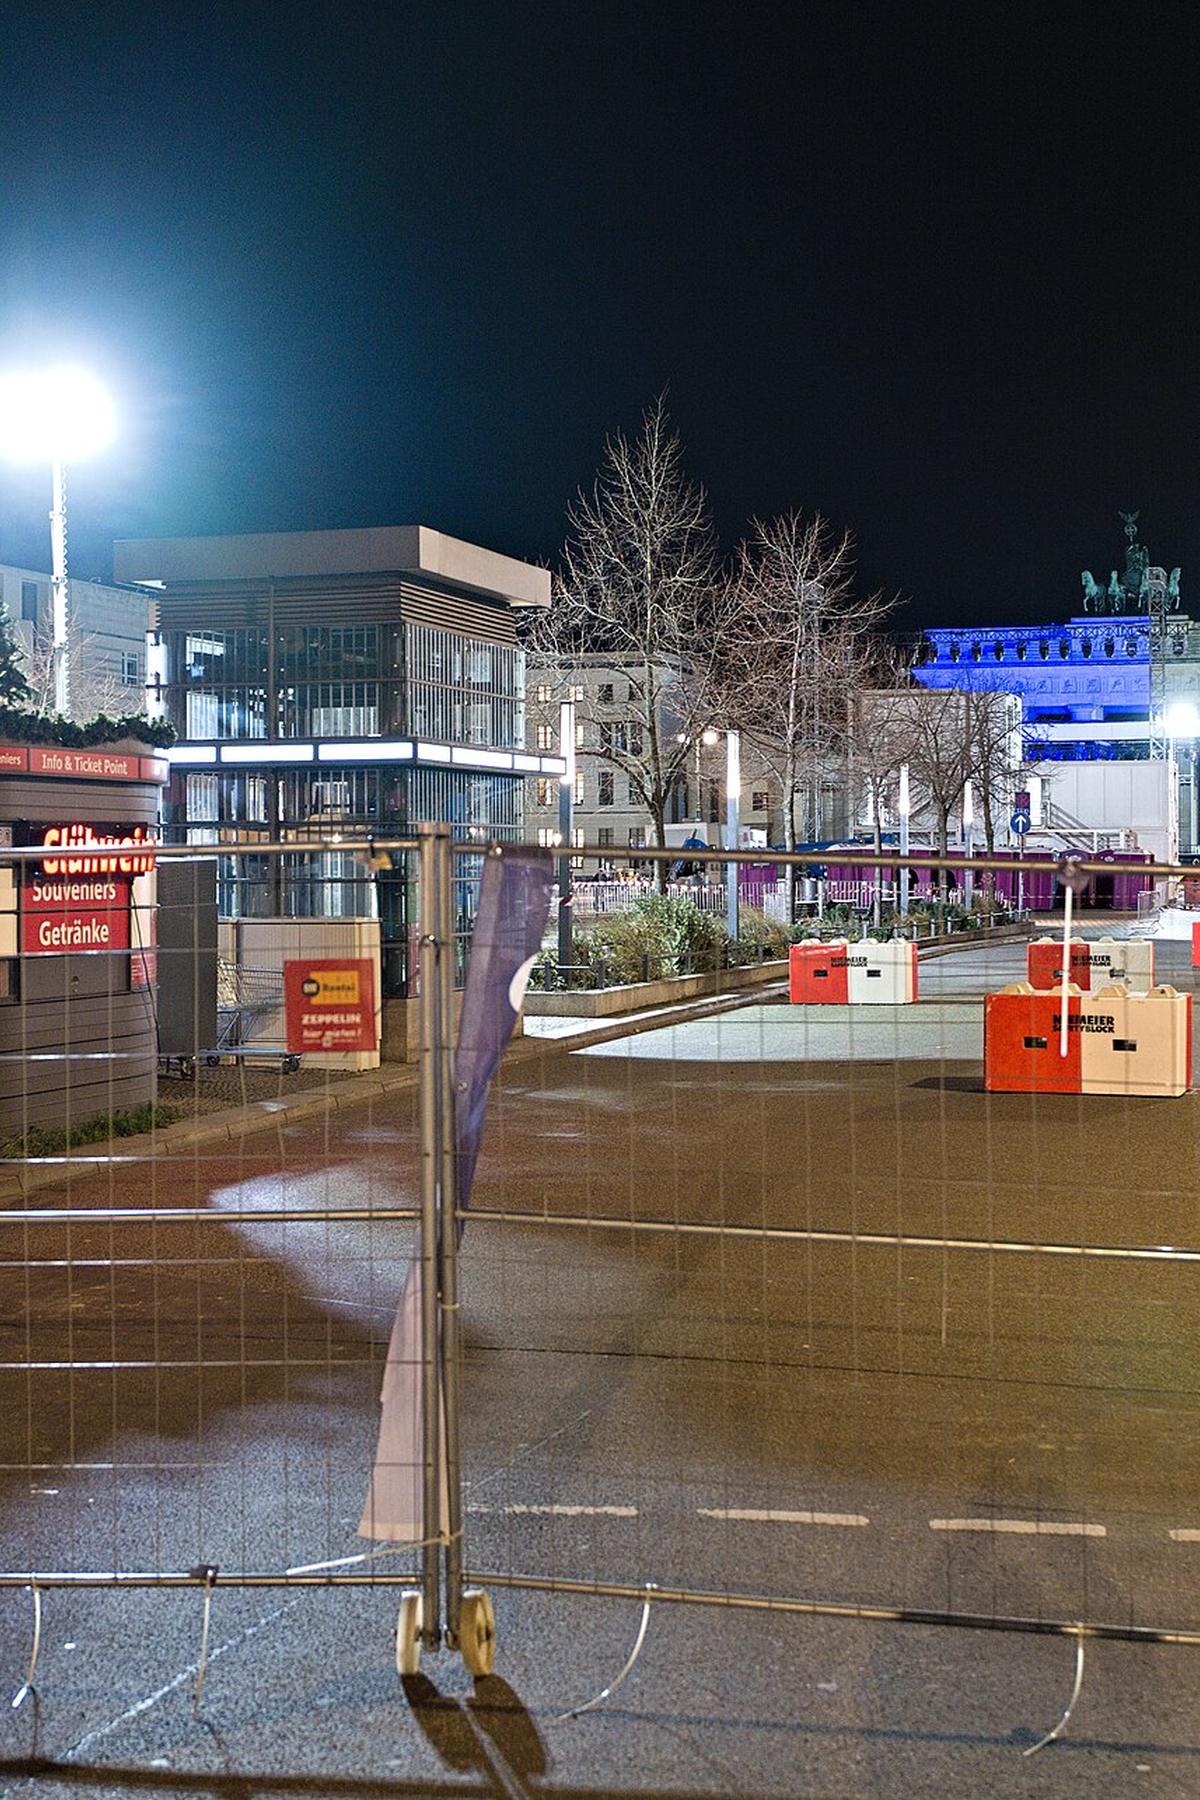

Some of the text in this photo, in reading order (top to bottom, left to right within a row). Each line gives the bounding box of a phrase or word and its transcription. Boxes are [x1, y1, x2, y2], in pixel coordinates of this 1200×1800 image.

[42, 754, 128, 775] Info & Ticket Point
[32, 879, 116, 901] Souveniers
[39, 918, 110, 946] Getränke
[1053, 1014, 1115, 1026] NEMEIER
